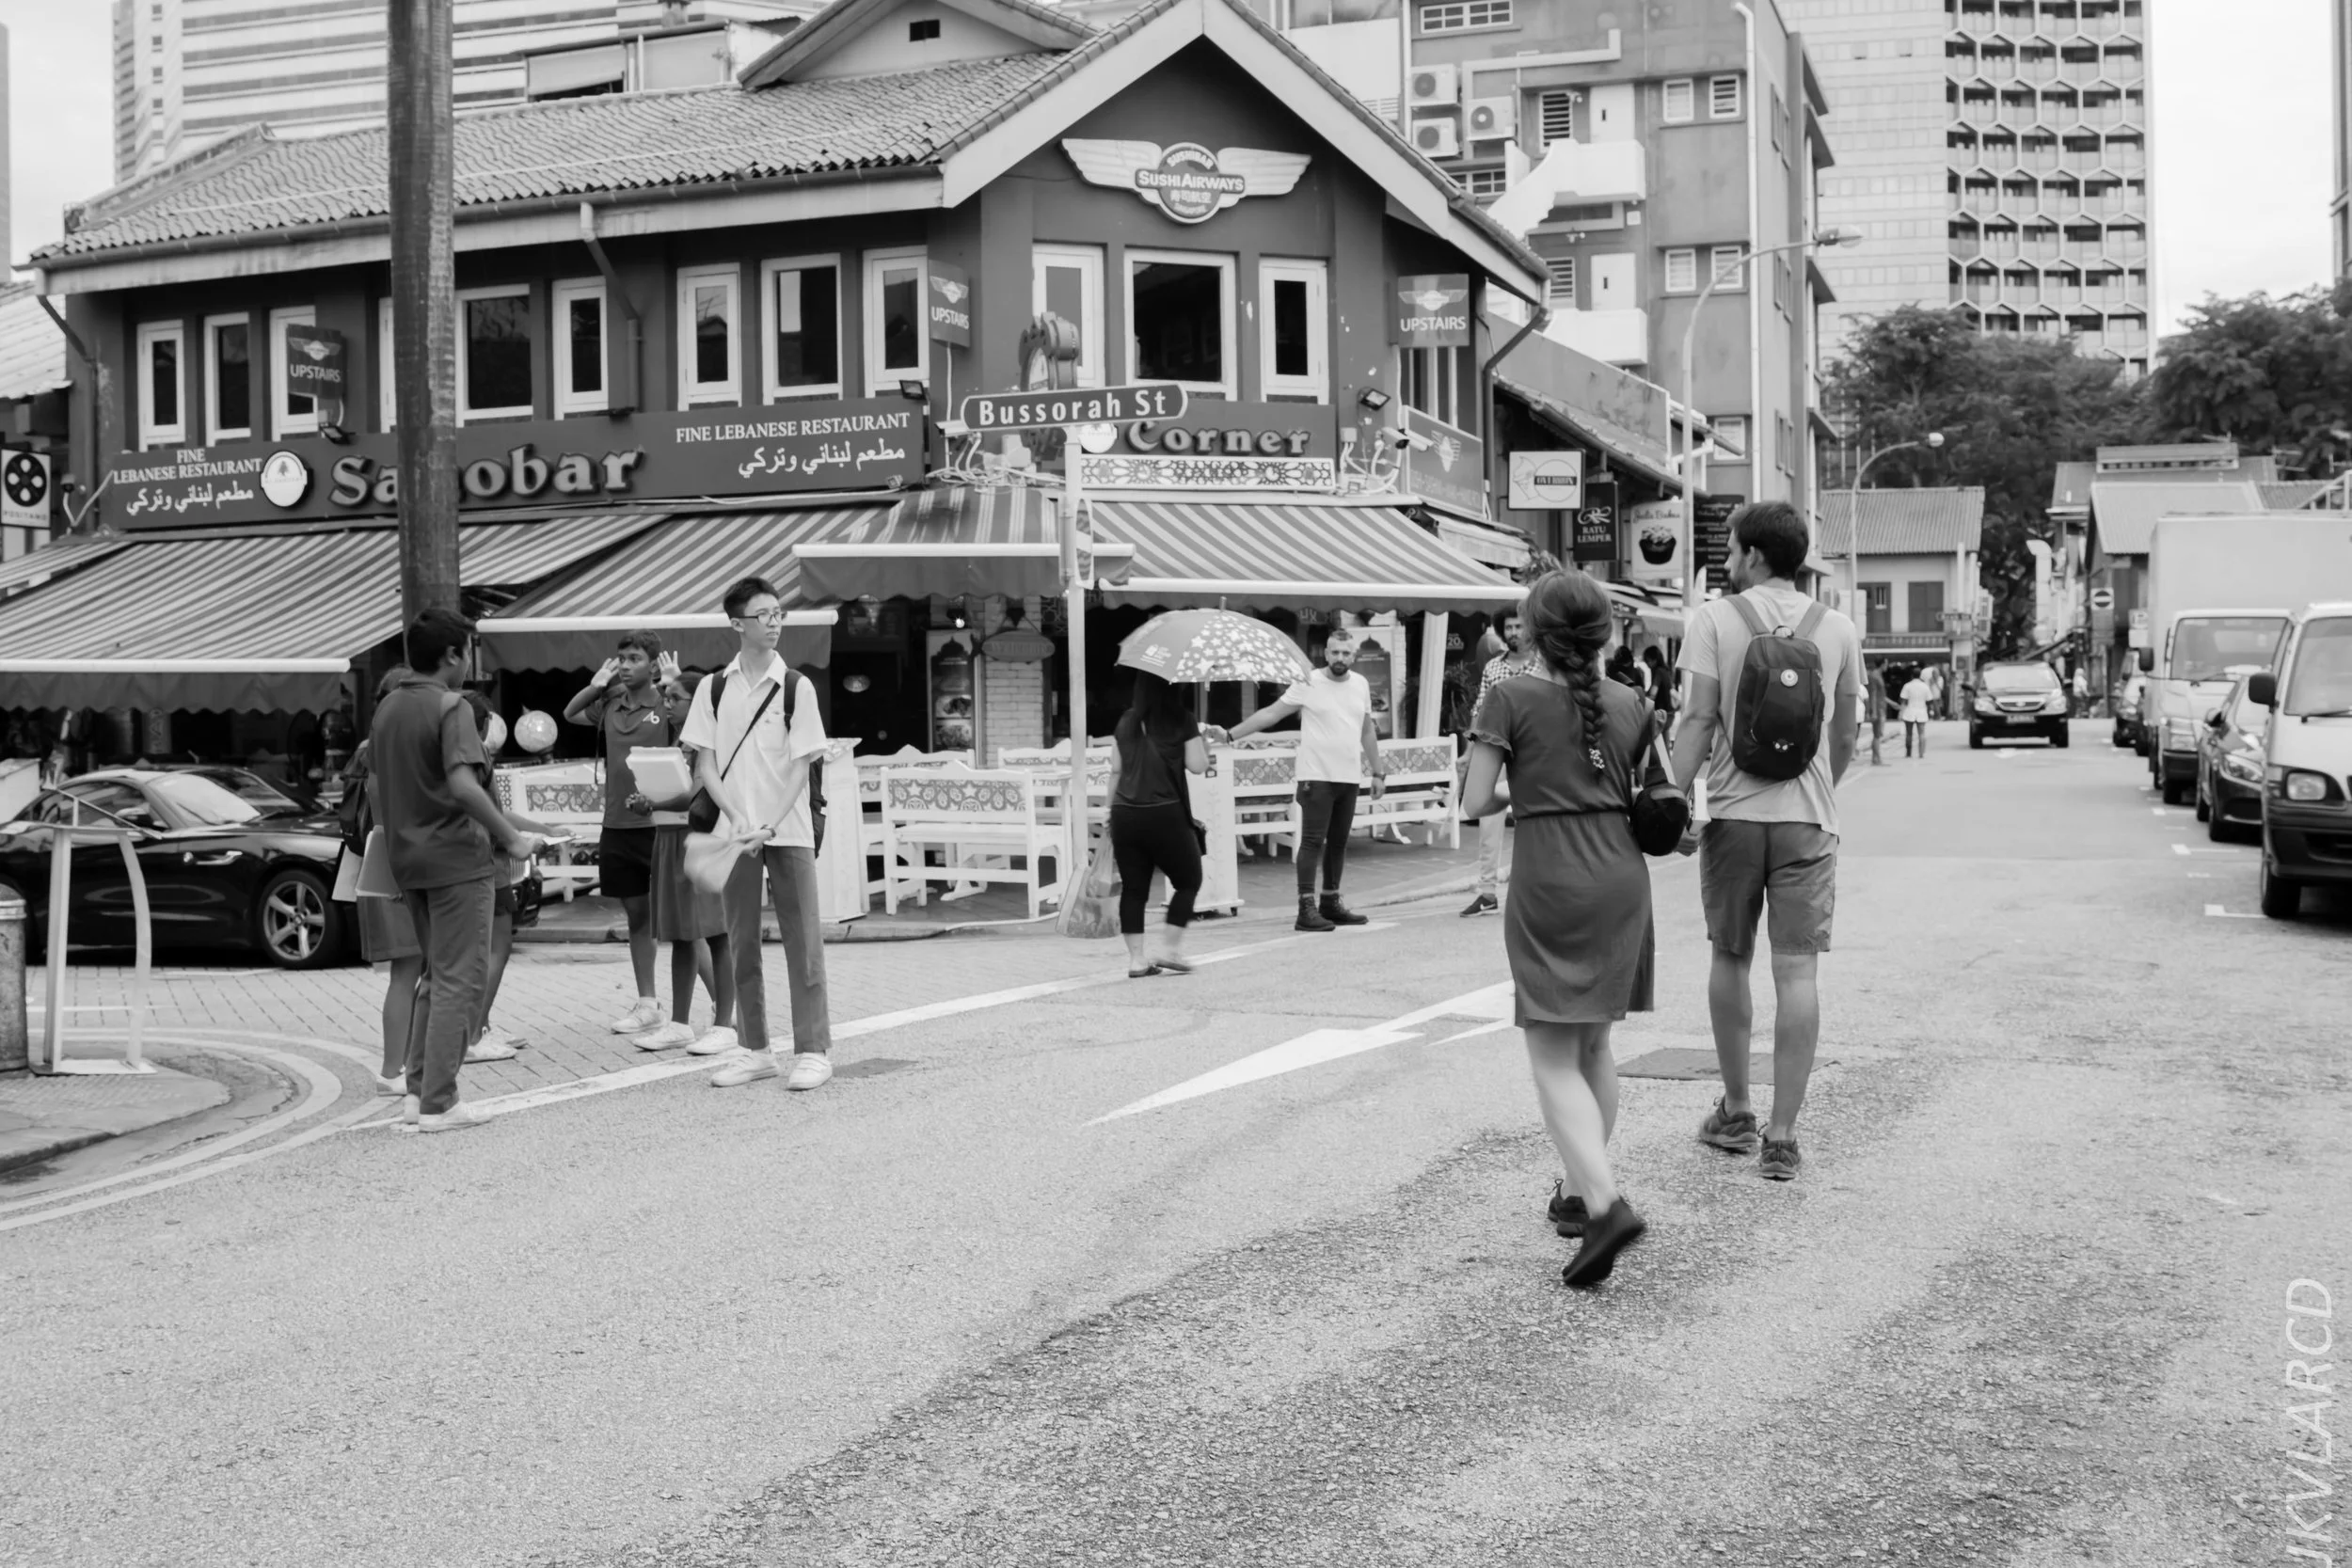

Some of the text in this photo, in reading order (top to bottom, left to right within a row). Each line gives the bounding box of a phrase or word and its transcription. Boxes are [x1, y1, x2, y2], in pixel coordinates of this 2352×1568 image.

[930, 306, 969, 330] UPSTAIRS
[1400, 316, 1466, 332] UPSTAIRS
[290, 363, 341, 382] UPSTAIRS
[979, 388, 1167, 426] Bussorah St
[676, 412, 910, 443] FINE LEBANESE RESTAURANT
[1128, 421, 1310, 455] Corner
[176, 449, 206, 464] FINE
[739, 438, 905, 479] مطعم لبناني وتركي
[113, 458, 263, 484] LEBANESE RESTAURANT
[330, 444, 644, 507] Saobar
[126, 481, 254, 515] مطعم لبناني وتركي
[1577, 534, 1612, 543] LEMPER
[1581, 526, 1607, 534] RATU
